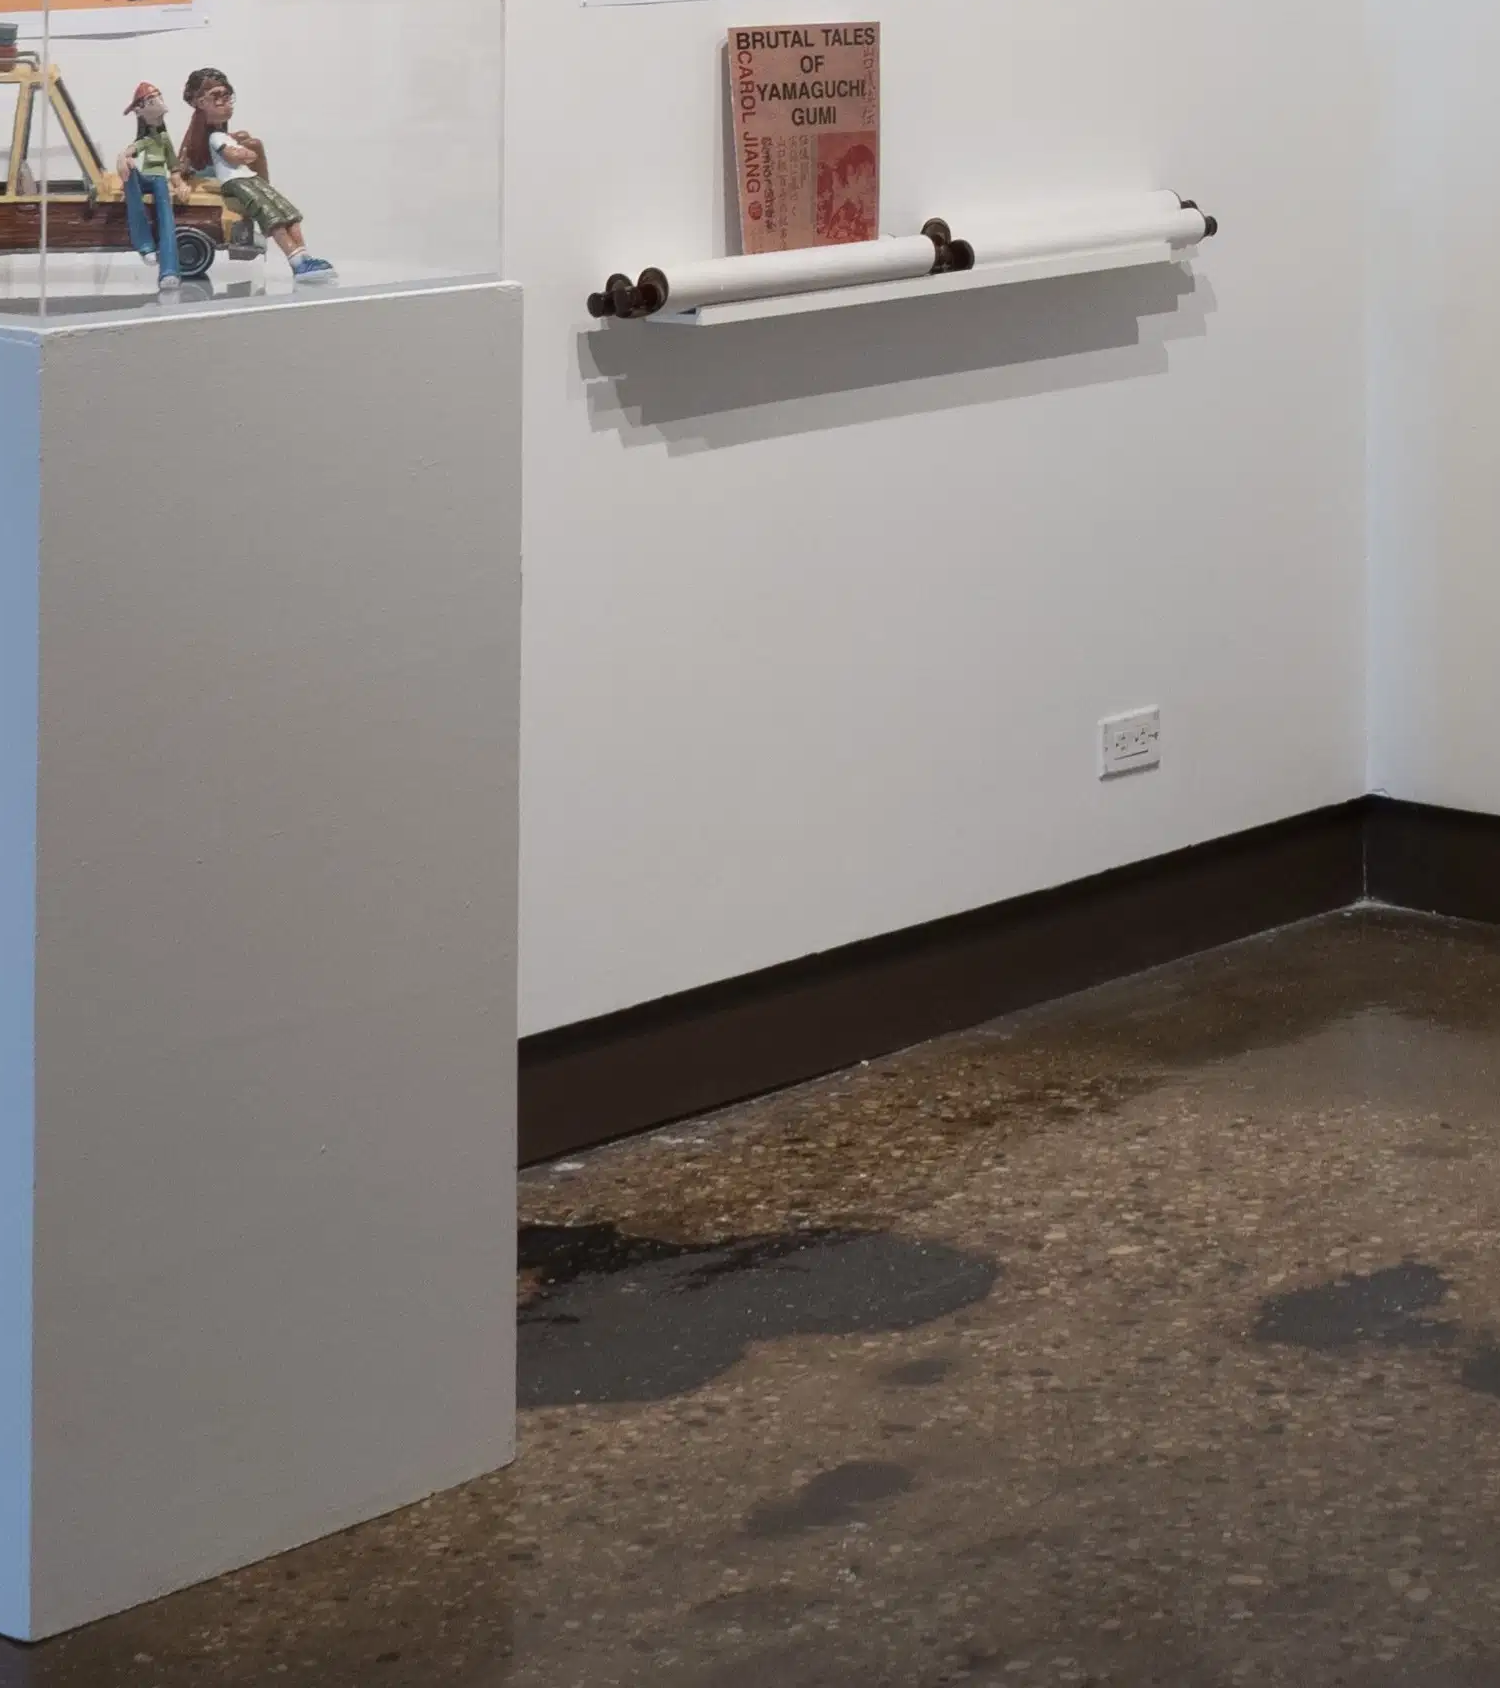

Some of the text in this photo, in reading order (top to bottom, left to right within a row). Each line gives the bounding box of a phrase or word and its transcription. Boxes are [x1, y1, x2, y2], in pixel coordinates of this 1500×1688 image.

[736, 27, 875, 50] BRUTAL TALES
[800, 55, 825, 73] OF
[757, 79, 866, 102] YAMAGUCHI
[737, 50, 762, 194] CAROL JIANG
[792, 106, 837, 126] GUMI
